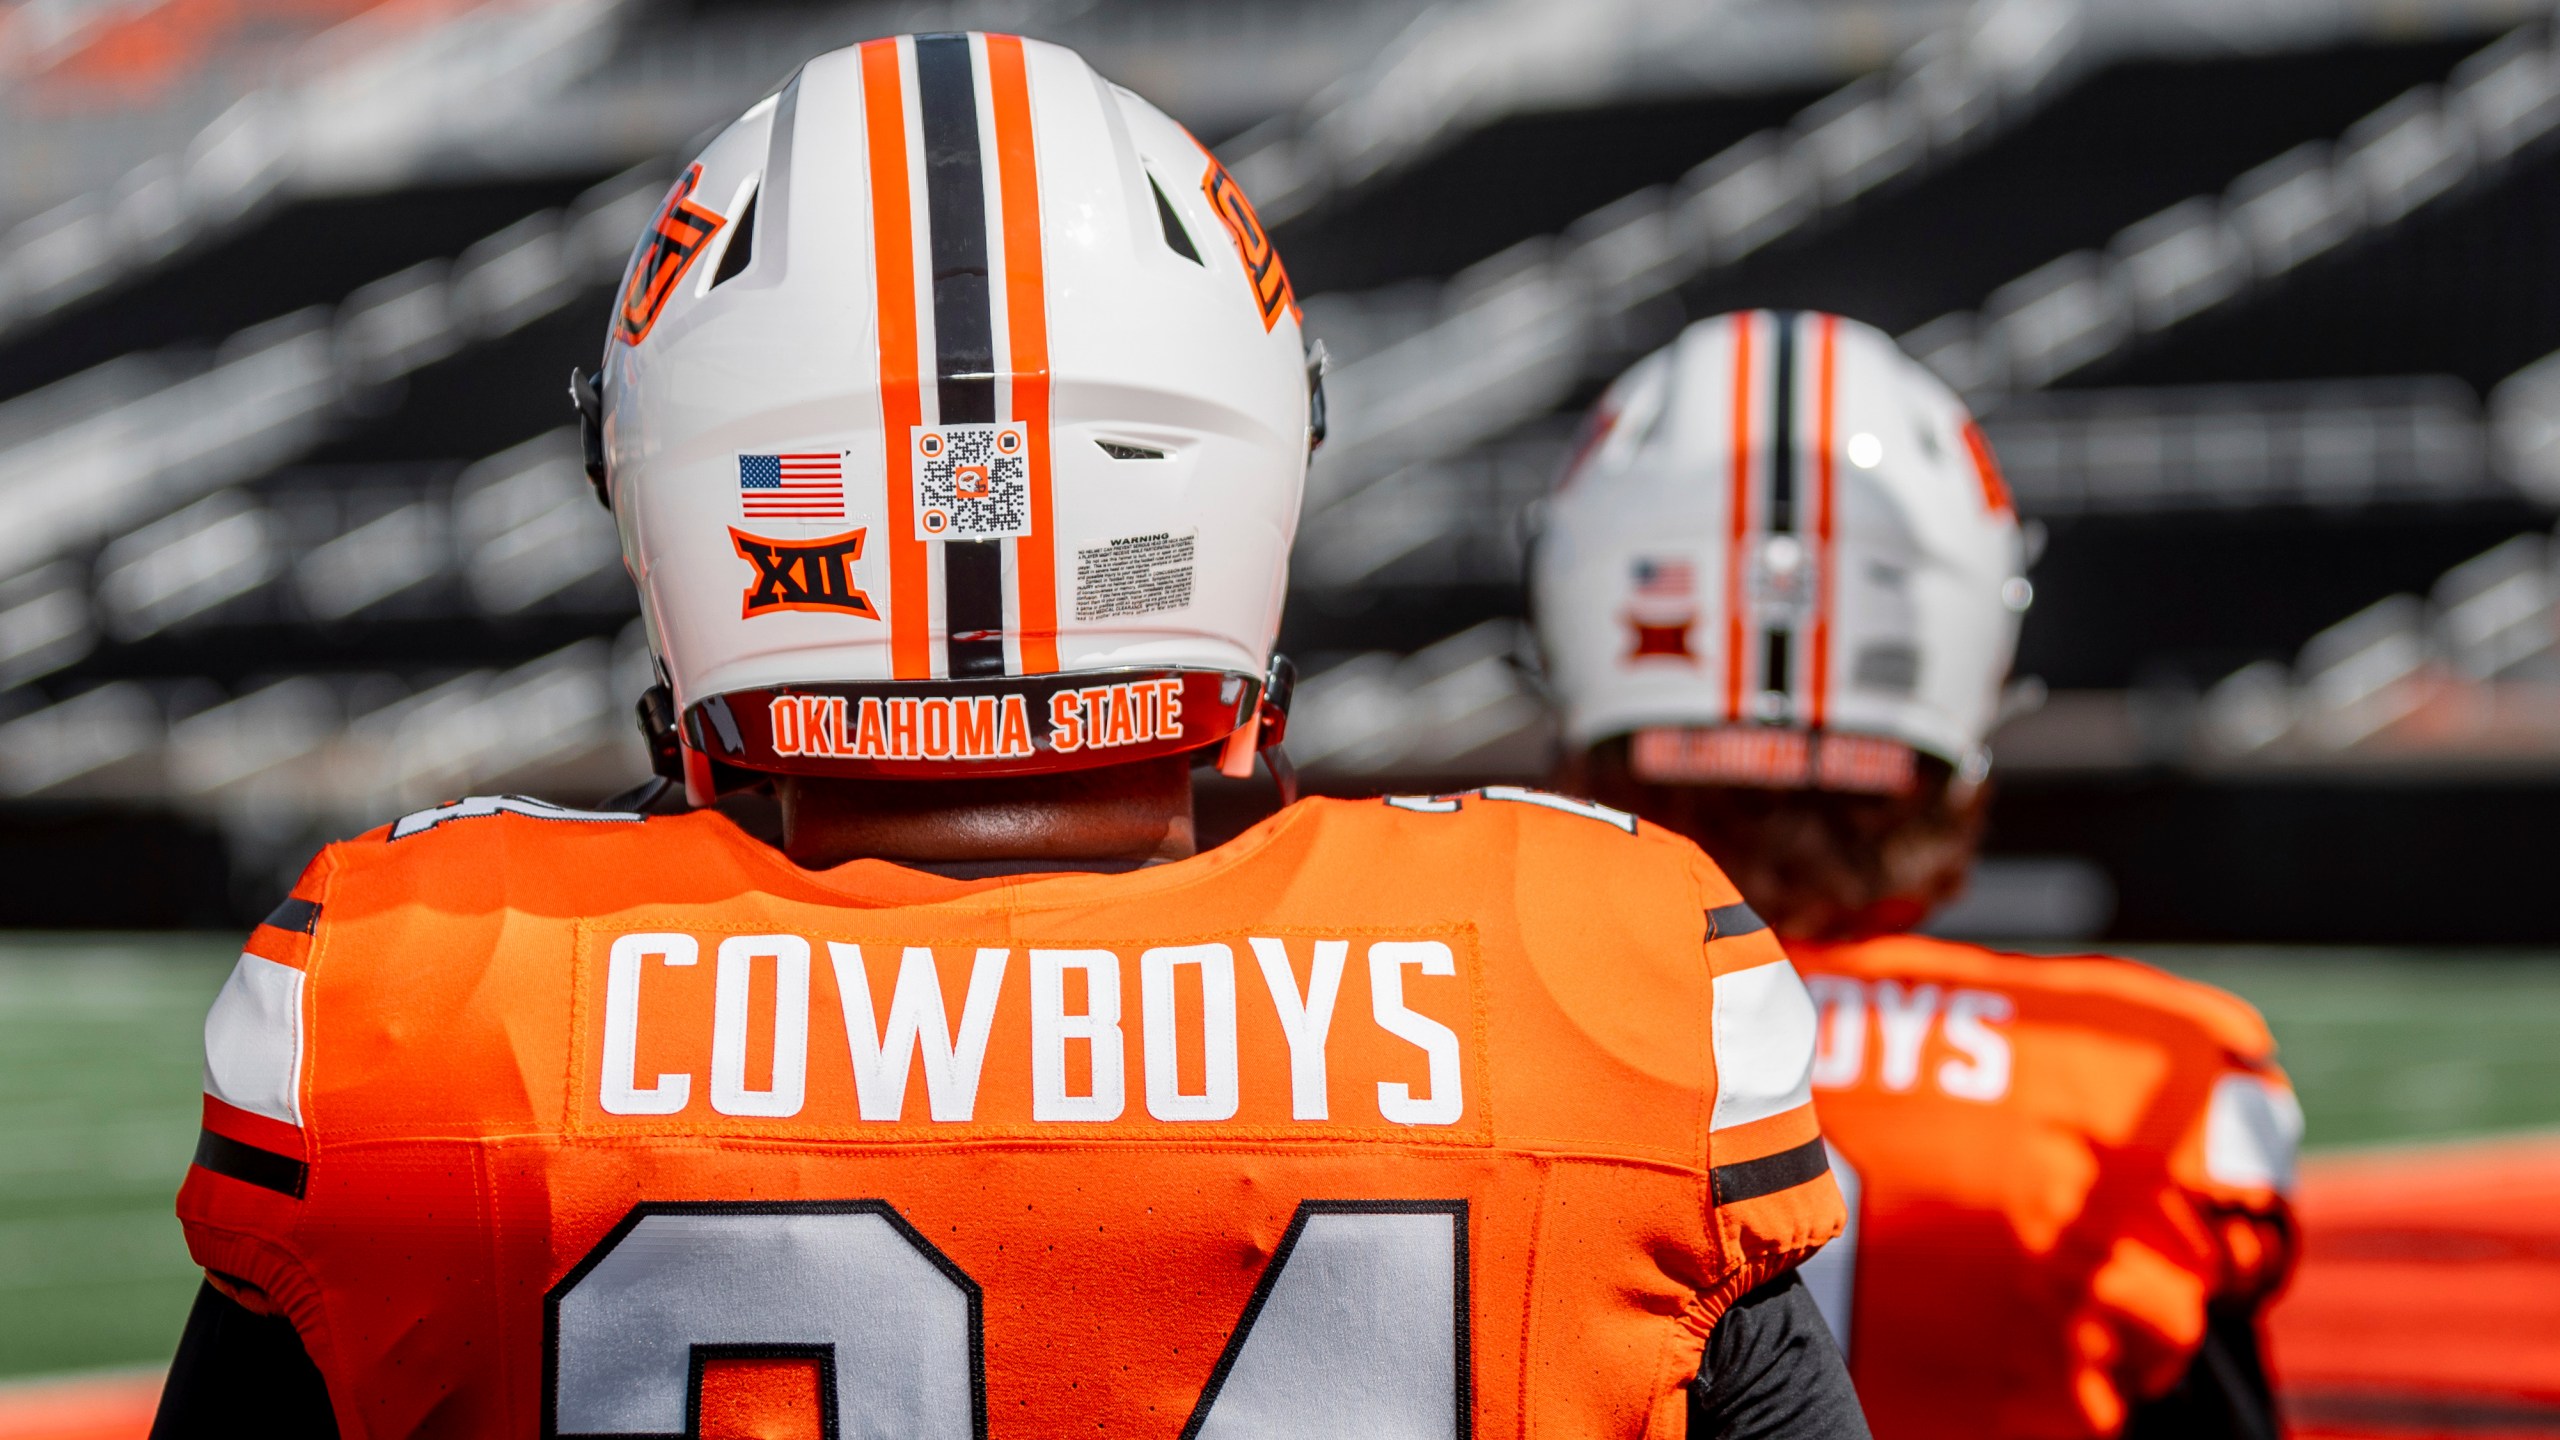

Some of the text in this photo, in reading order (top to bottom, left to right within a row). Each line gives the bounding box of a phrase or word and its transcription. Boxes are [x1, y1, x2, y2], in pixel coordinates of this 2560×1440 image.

[737, 536, 868, 610] XII
[1110, 532, 1169, 546] WARNING
[769, 678, 1184, 760] OKLAHOMA STATE
[599, 932, 1464, 1126] COWBOYS
[1808, 975, 2016, 1102] OYS
